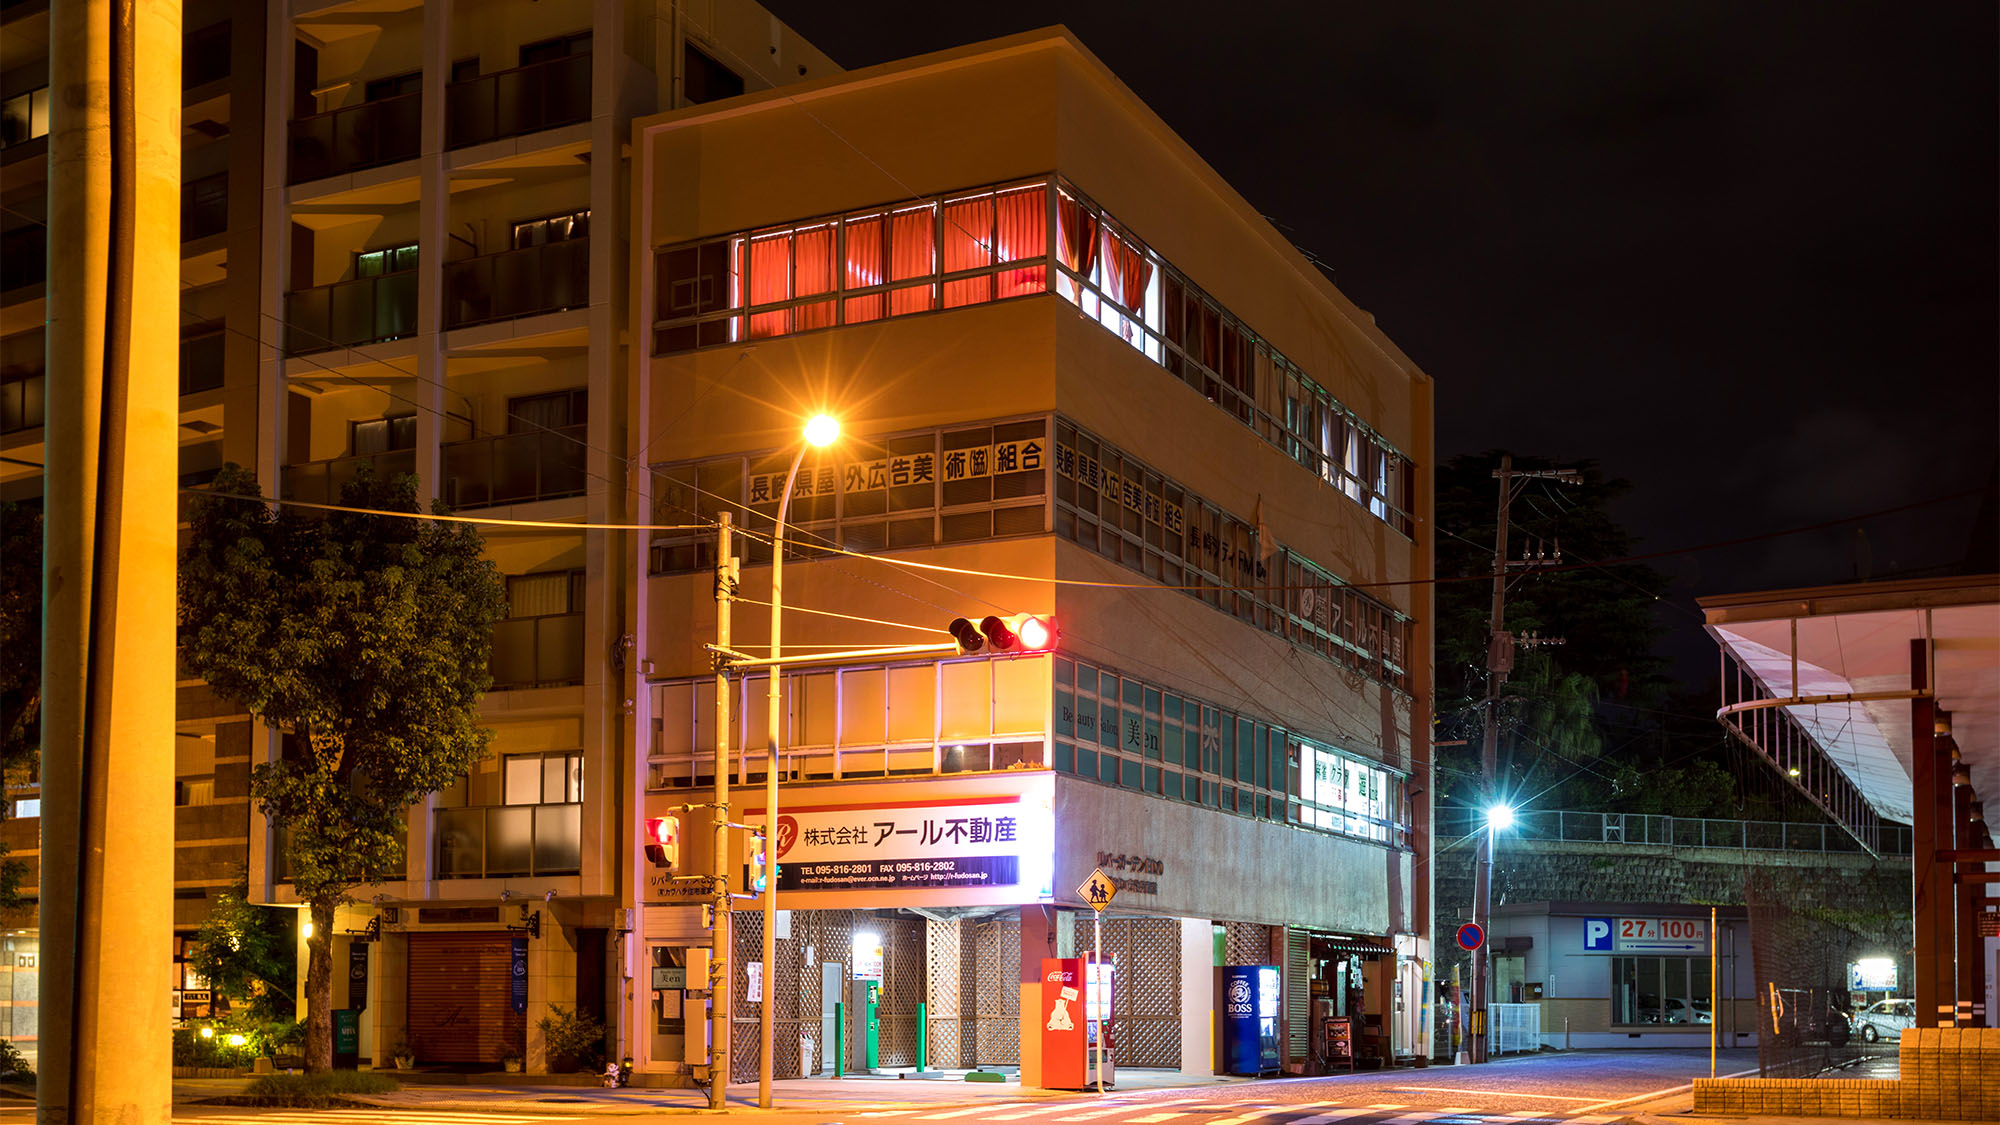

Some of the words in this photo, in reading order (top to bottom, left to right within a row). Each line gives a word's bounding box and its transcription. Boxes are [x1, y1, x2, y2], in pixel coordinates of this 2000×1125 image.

[1063, 706, 1095, 729] Beauty
[1128, 719, 1158, 750] 美en
[804, 826, 868, 846] 株式会社
[873, 817, 1017, 848] アール不動産
[800, 867, 814, 875] TEL
[815, 864, 872, 874] 095-816-2801
[880, 865, 894, 873] FAX
[896, 861, 955, 872] 095-816-2802
[930, 871, 988, 880] http://r-fudosan.jp
[1587, 920, 1609, 947] P
[1622, 920, 1655, 938] 27分
[1661, 921, 1704, 939] 100円
[1047, 971, 1073, 982] Coca-Cola
[1230, 979, 1250, 988] COFFEE
[1228, 1003, 1252, 1013] BOSS
